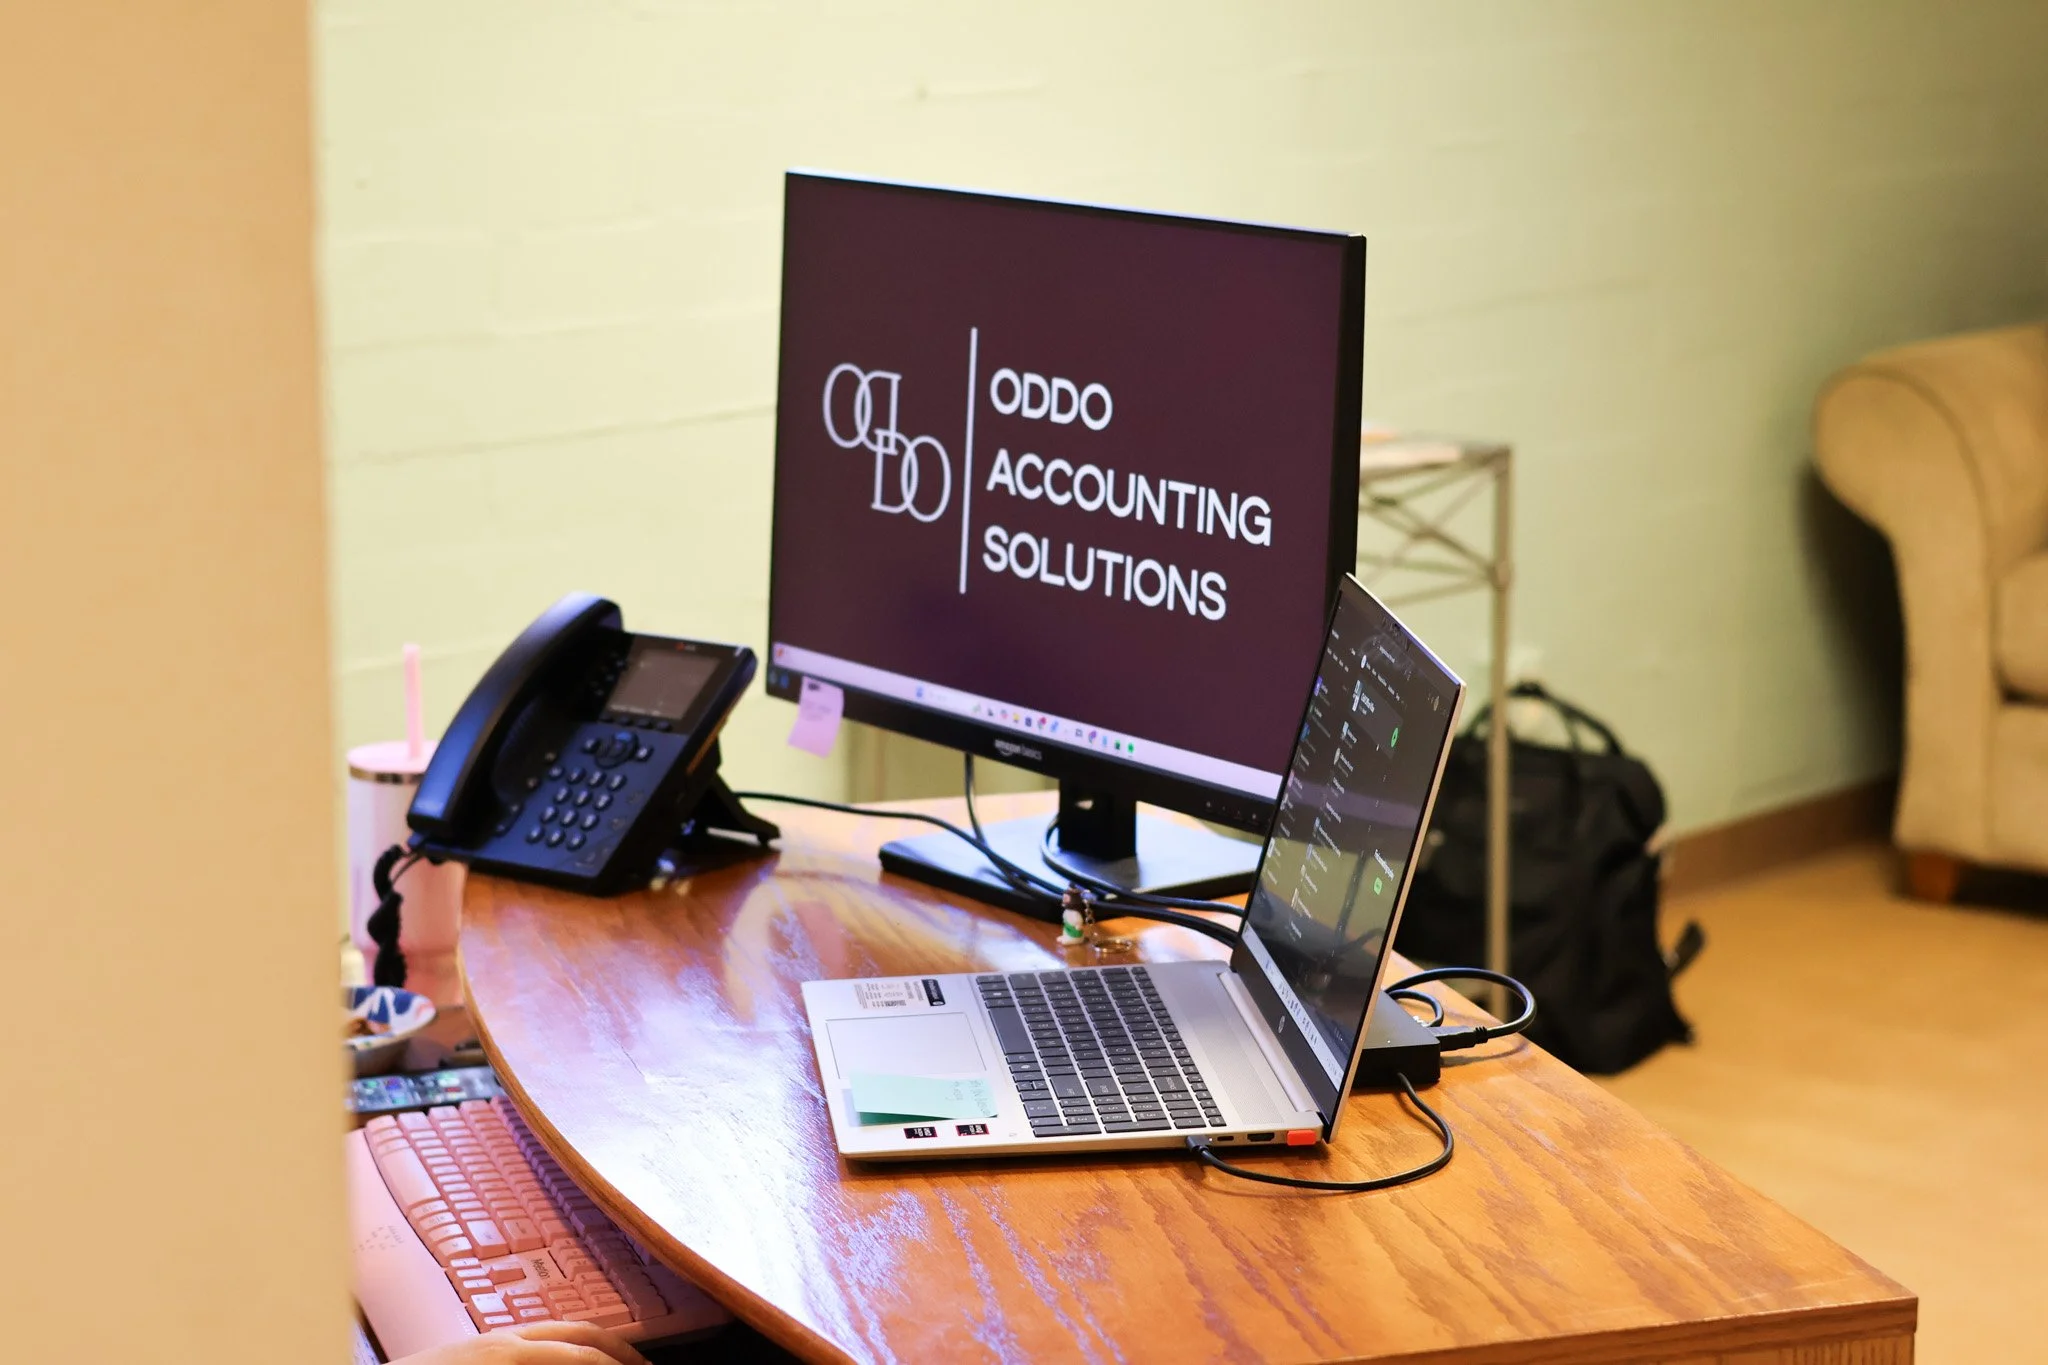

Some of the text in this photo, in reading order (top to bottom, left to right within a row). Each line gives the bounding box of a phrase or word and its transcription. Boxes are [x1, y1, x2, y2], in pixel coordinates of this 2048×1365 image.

[989, 367, 1113, 431] ODDO
[985, 447, 1273, 547] ACCOUNTING
[982, 524, 1228, 621] SOLUTIONS
